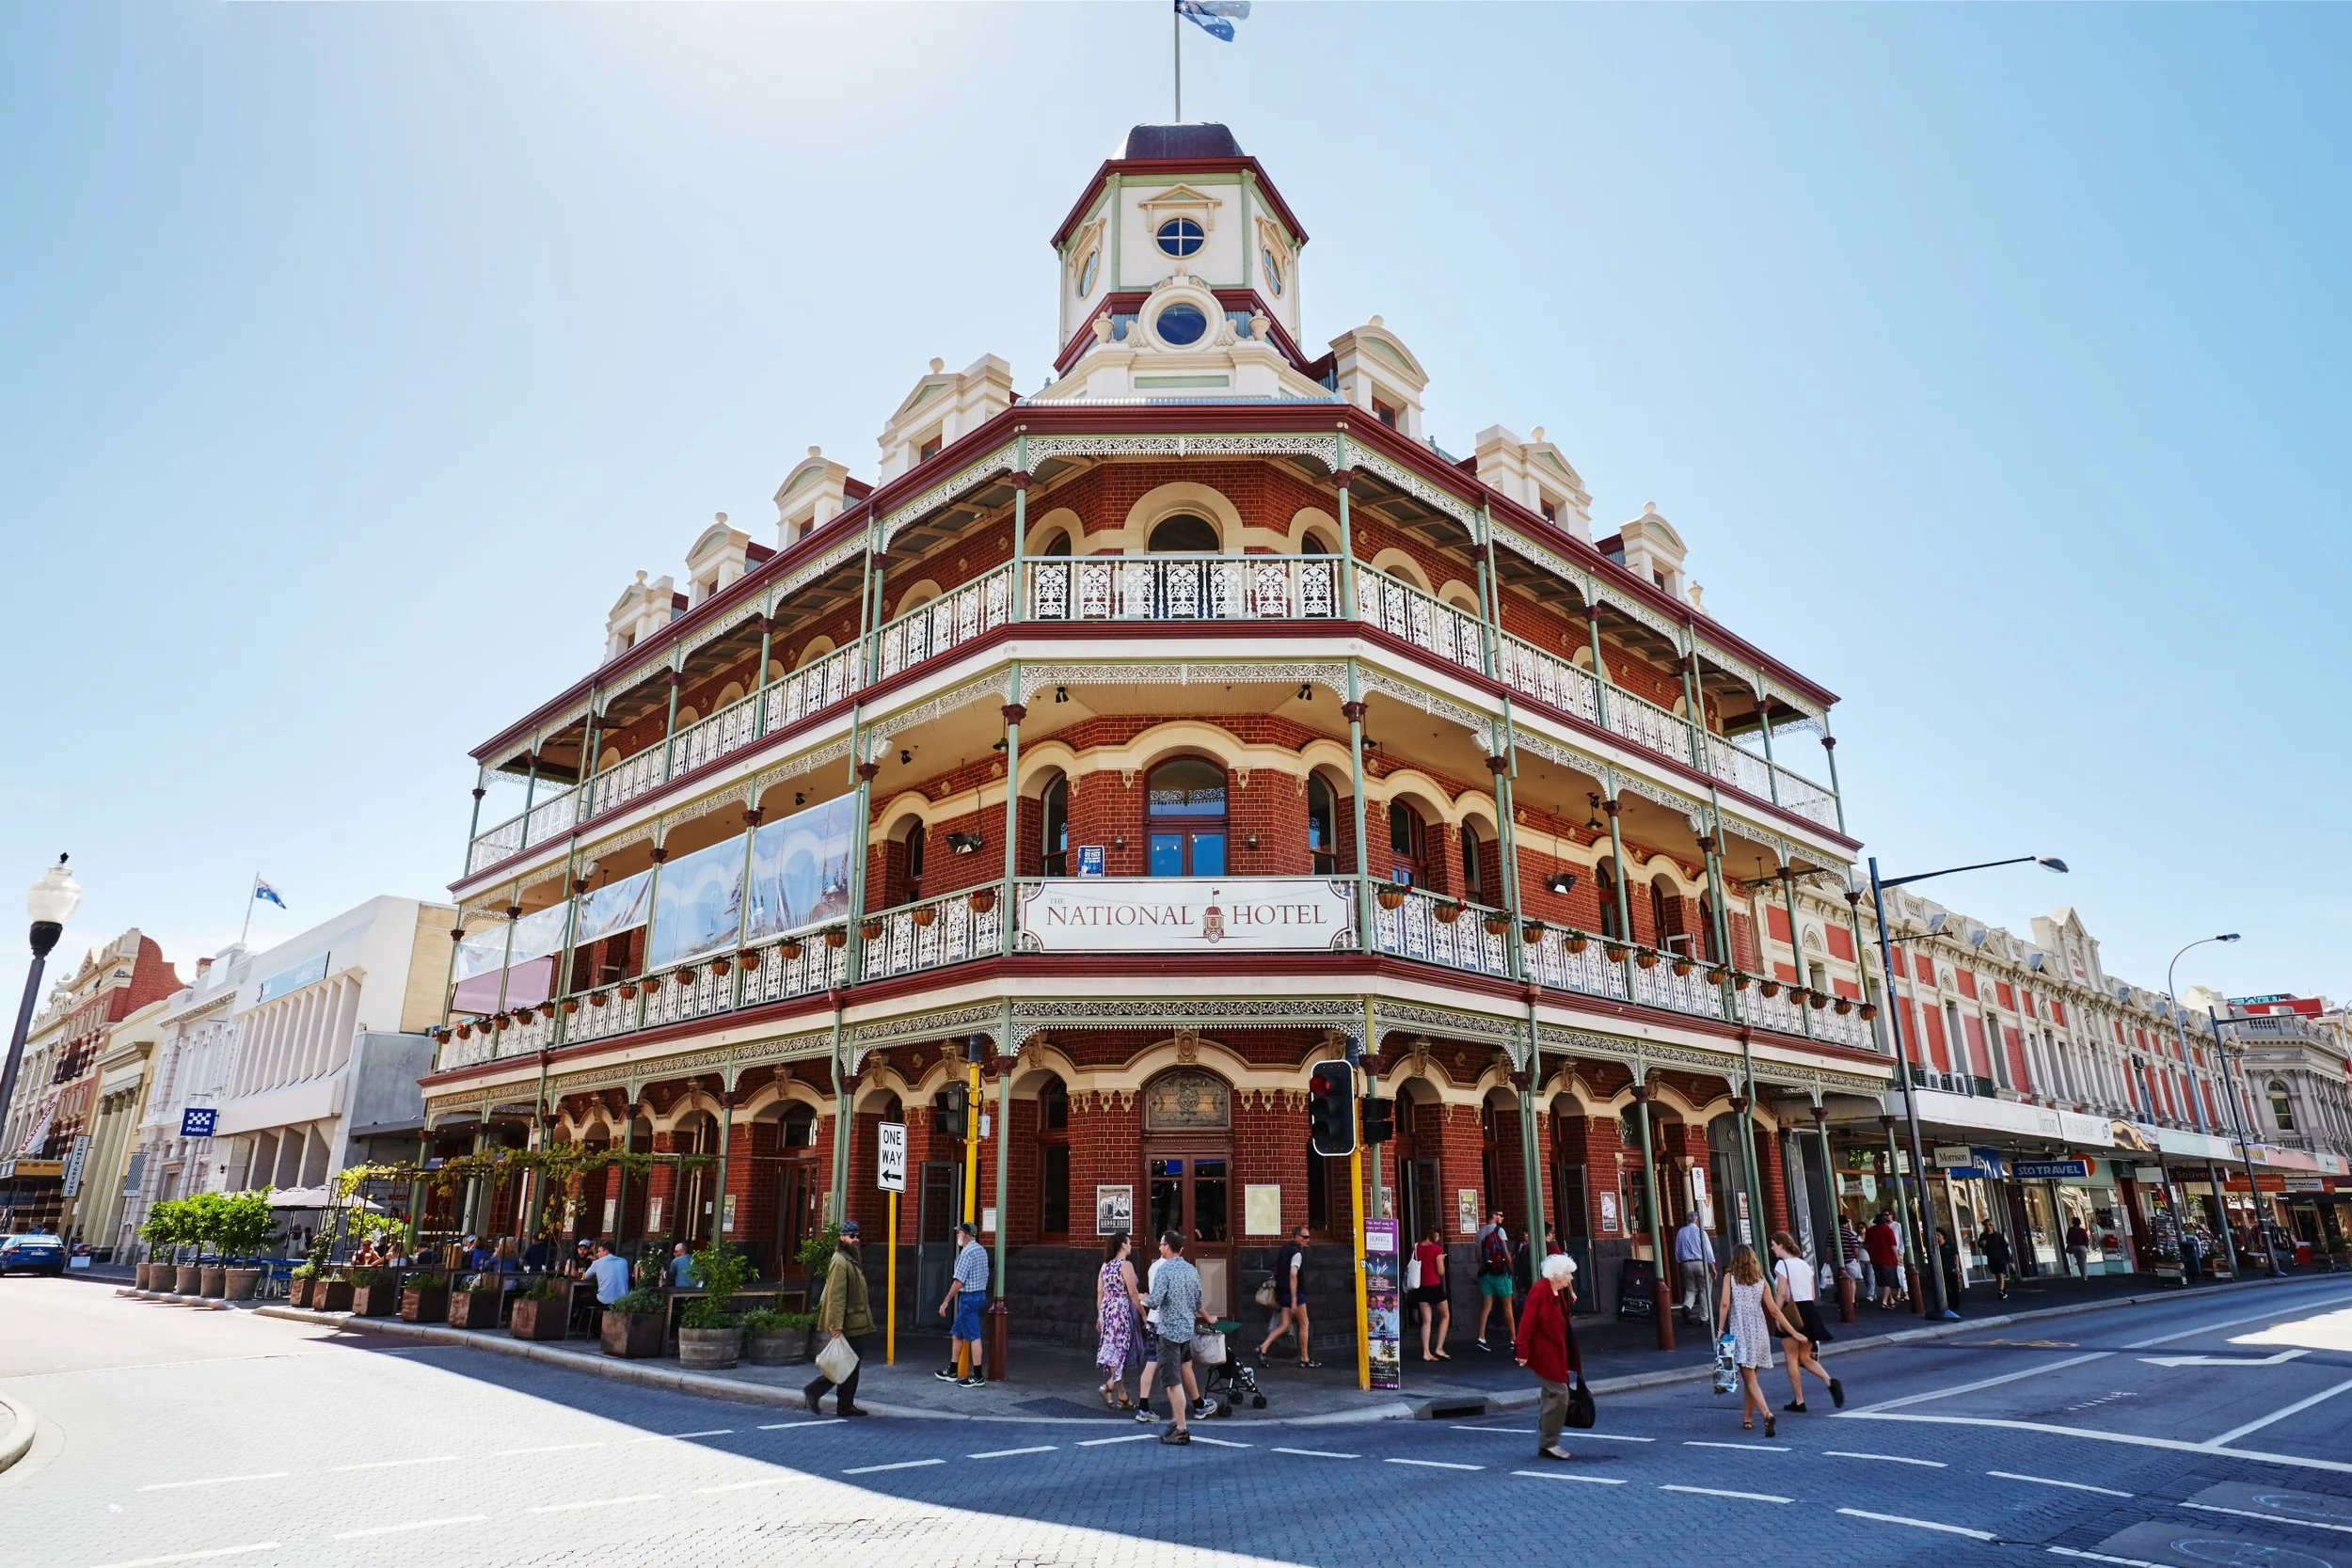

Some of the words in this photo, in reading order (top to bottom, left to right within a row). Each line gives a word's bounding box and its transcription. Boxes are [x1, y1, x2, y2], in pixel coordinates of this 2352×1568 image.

[1047, 906, 1194, 926] NATIONAL
[1233, 905, 1327, 925] HOTEL
[883, 1130, 902, 1145] ONE
[882, 1149, 902, 1165] WAY
[1939, 1151, 1967, 1163] Morrison
[2037, 1164, 2081, 1175] TRAVEL
